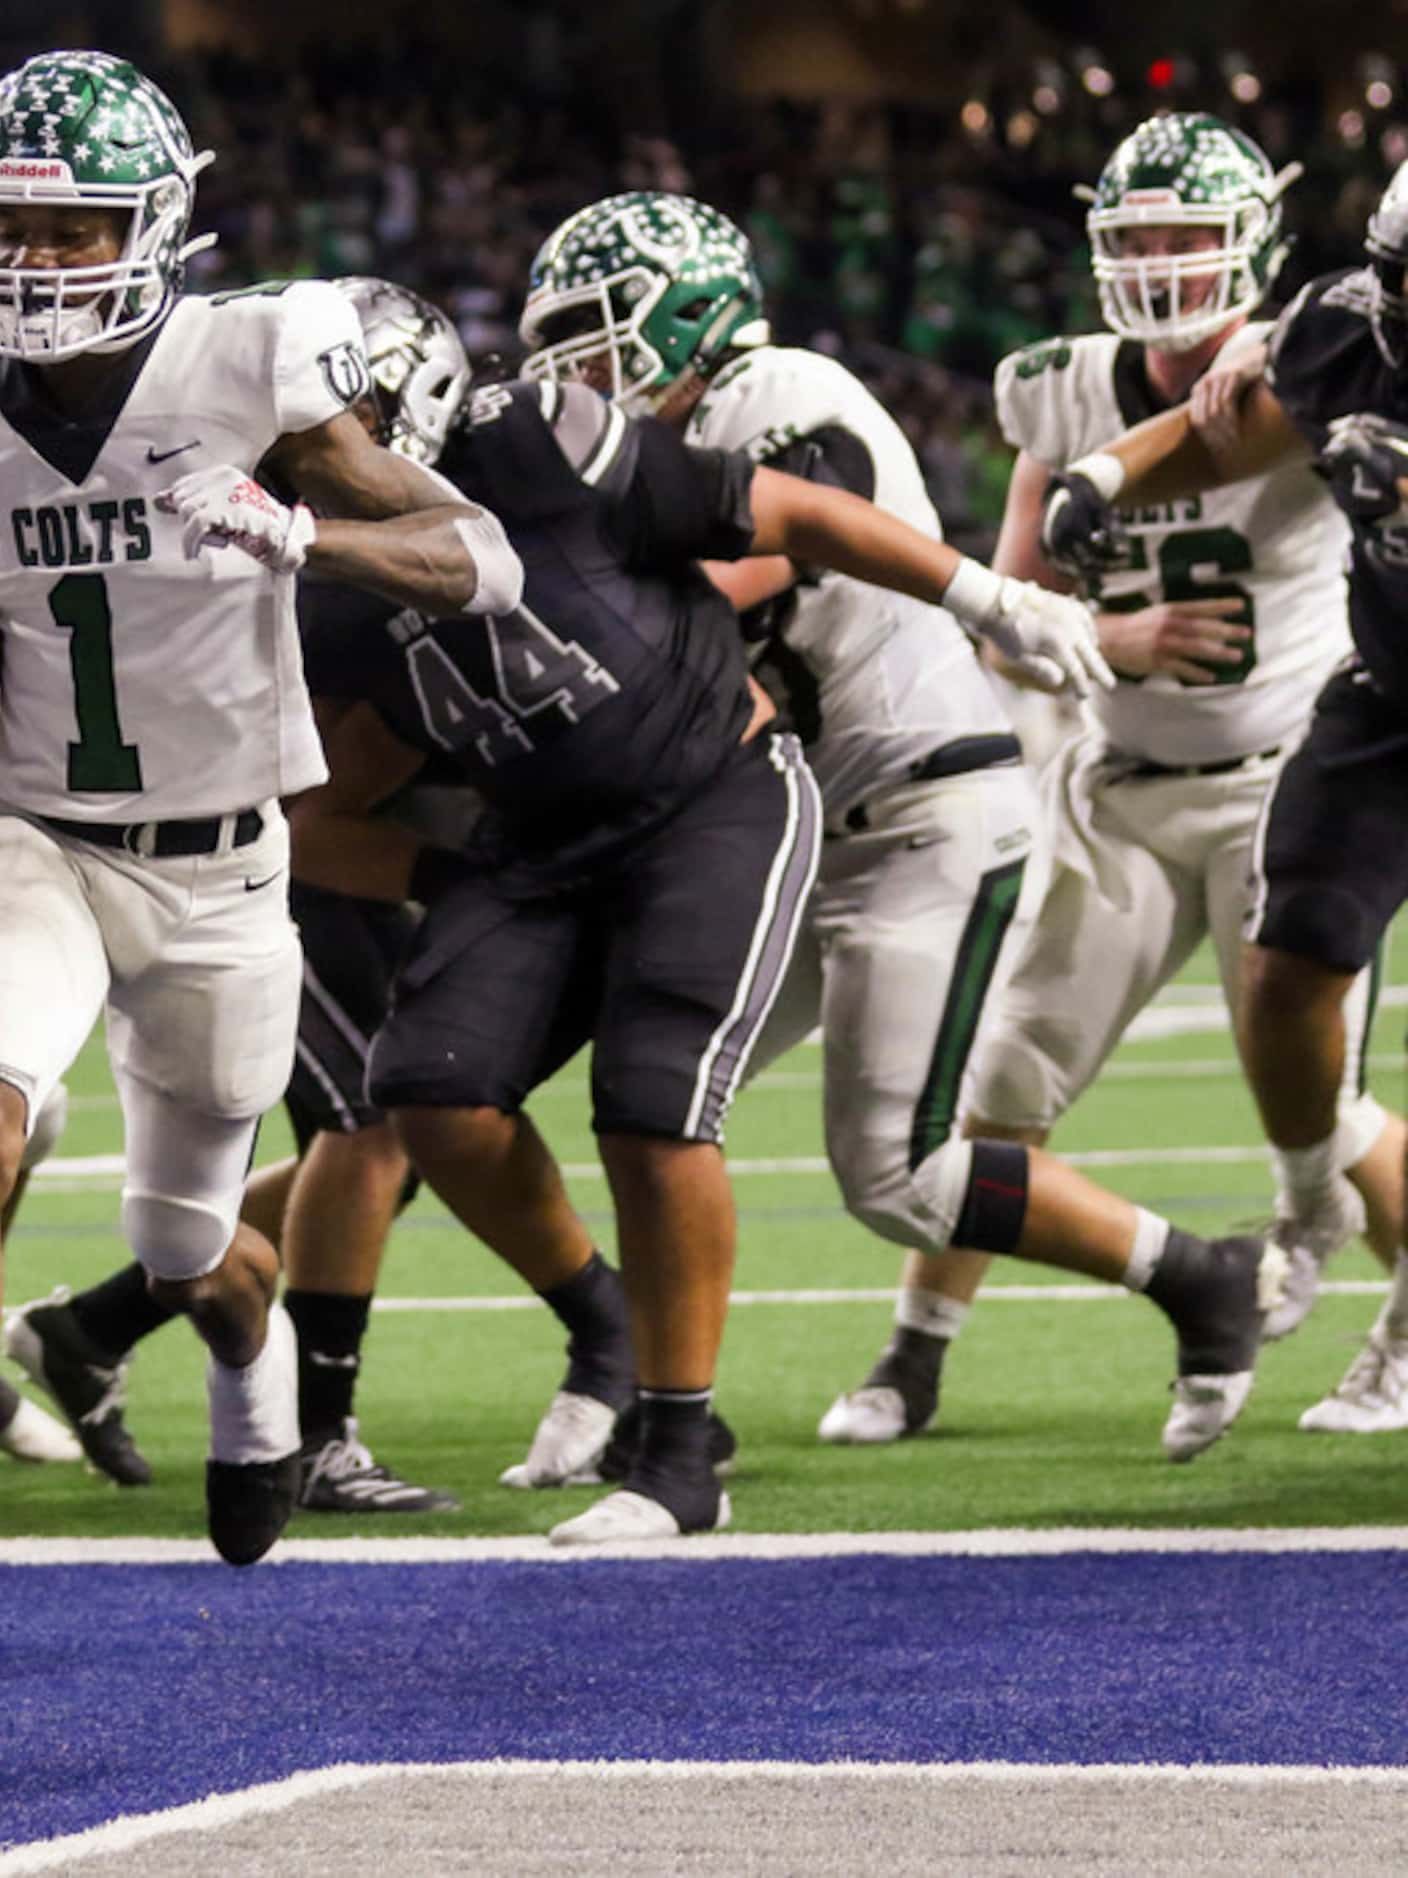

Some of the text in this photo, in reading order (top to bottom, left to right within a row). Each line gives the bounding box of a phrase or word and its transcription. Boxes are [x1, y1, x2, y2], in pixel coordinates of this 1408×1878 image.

[12, 498, 152, 567] COLTS
[48, 573, 144, 792] 1
[405, 603, 621, 766] 44
